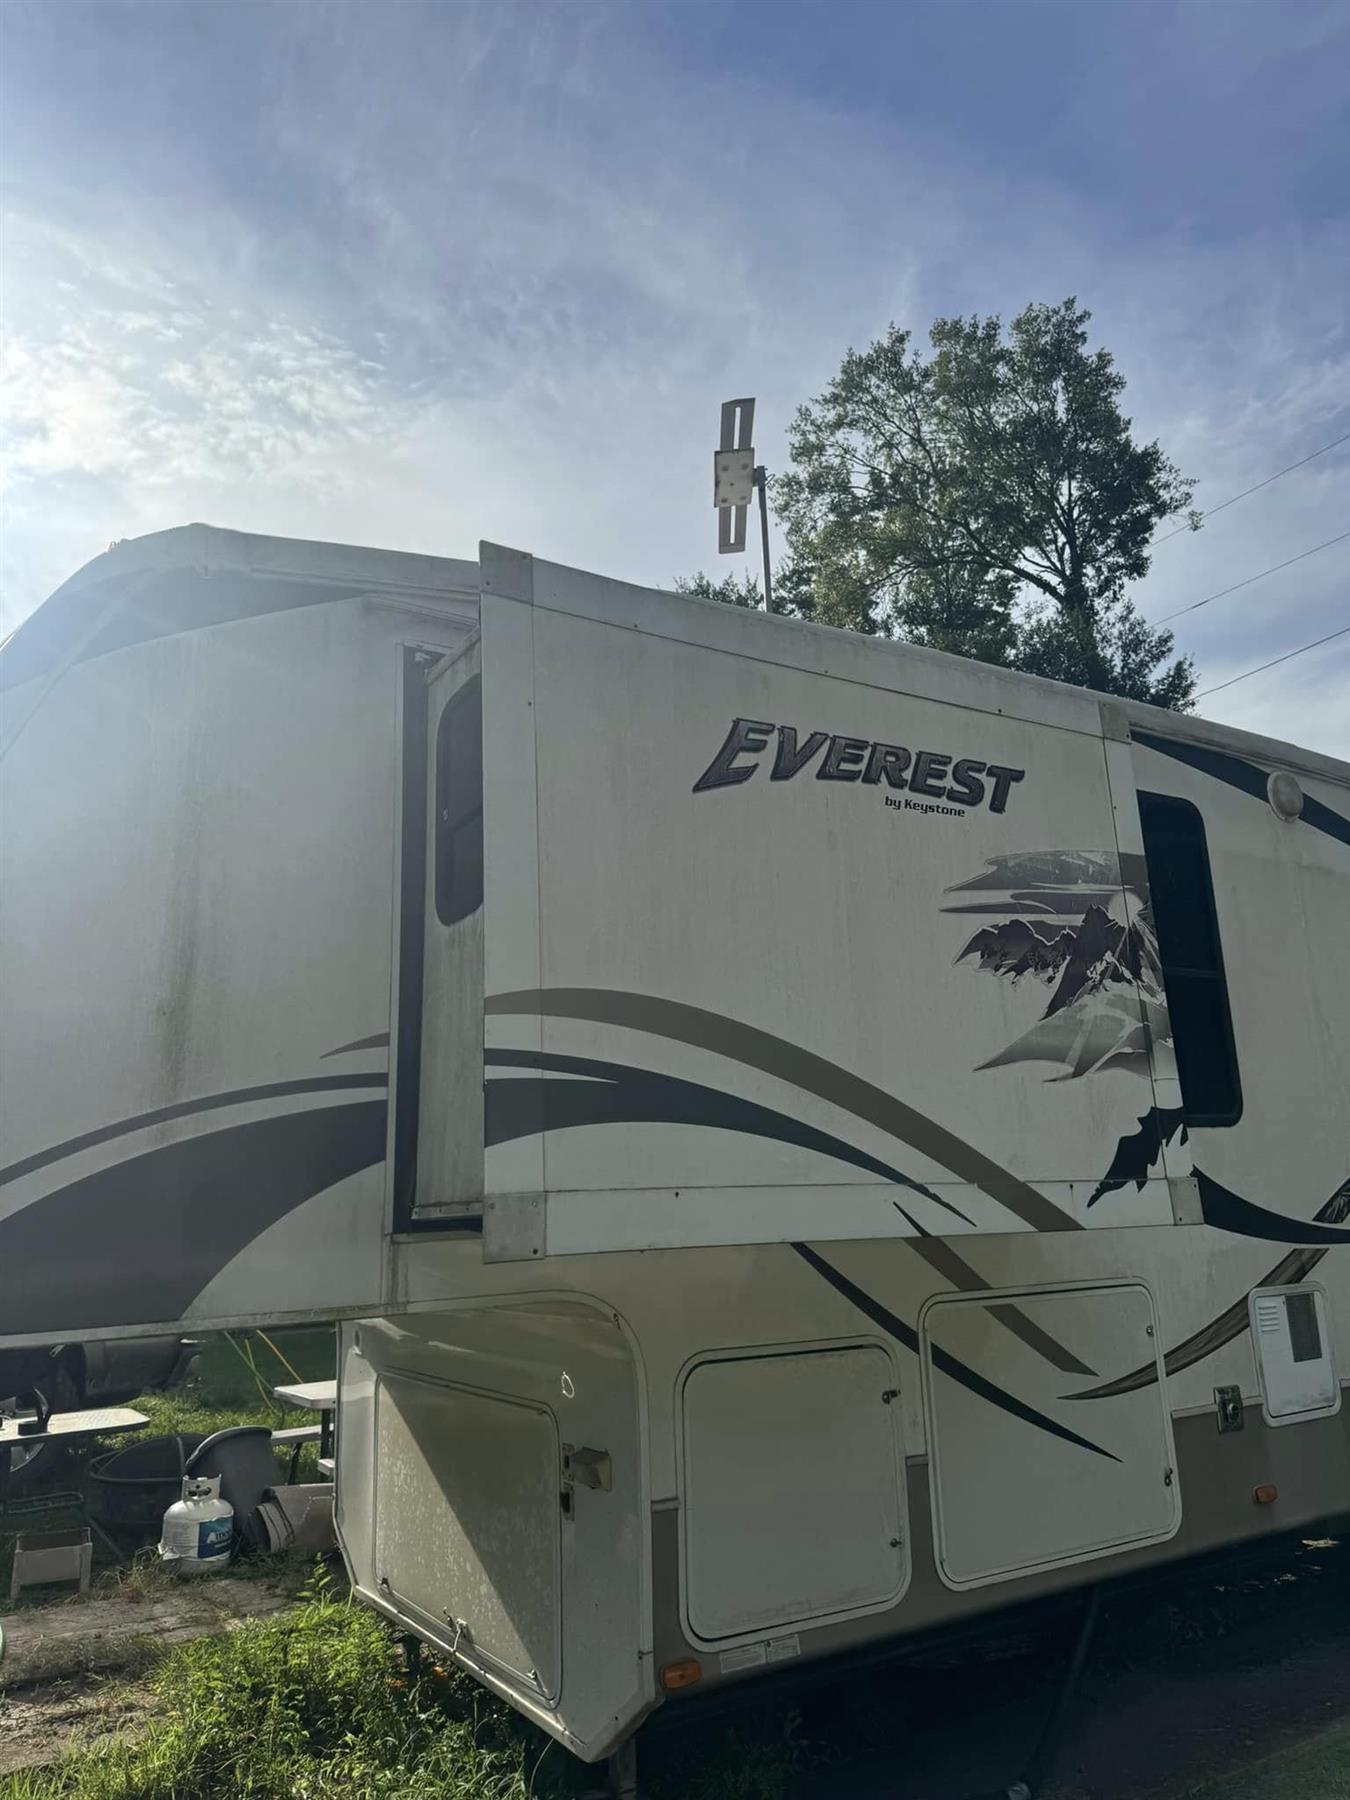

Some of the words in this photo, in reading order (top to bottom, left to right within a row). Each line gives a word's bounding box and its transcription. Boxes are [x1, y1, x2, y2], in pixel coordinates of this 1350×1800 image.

[692, 717, 1025, 814] EVEREST
[884, 795, 901, 811] by
[903, 798, 966, 818] Keystone
